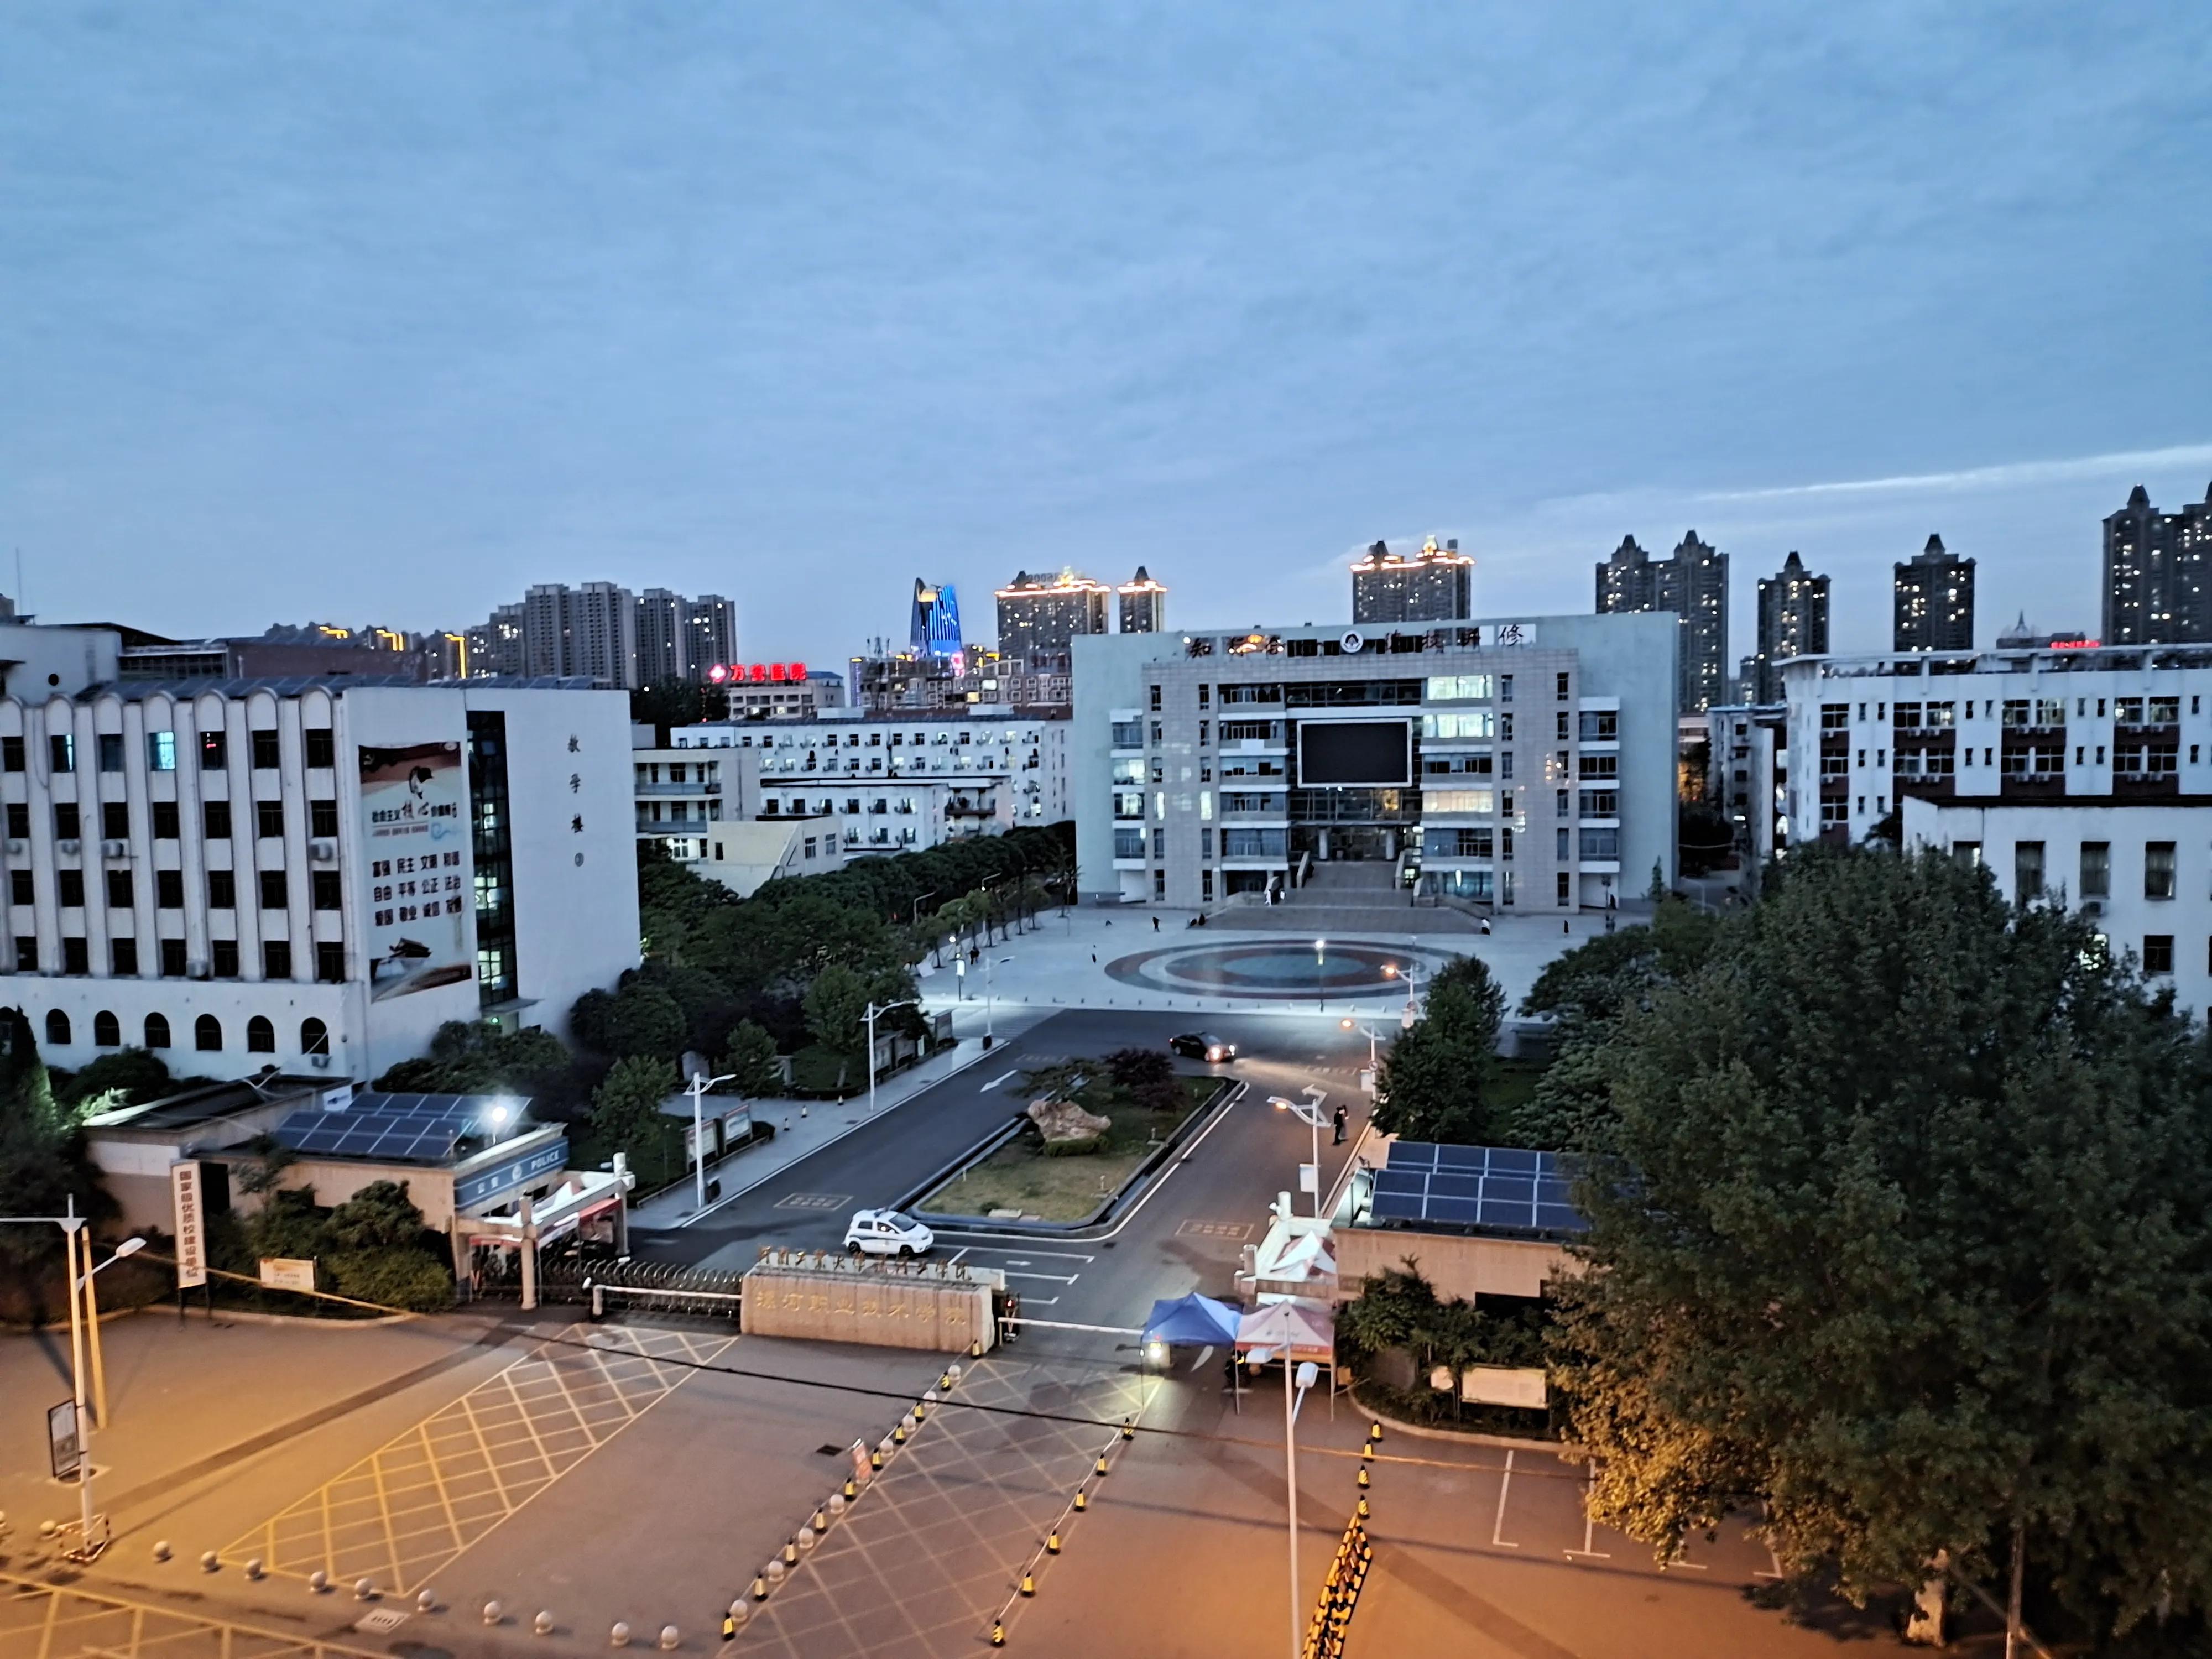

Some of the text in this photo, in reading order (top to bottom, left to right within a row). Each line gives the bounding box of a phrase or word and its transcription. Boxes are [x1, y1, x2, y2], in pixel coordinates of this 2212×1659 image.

[397, 857, 415, 874] 民主
[420, 854, 437, 870] 文明
[373, 885, 392, 902] 自由
[398, 881, 415, 898] 平等
[422, 878, 439, 894] 公正
[530, 1150, 560, 1171] POLICE
[756, 1291, 967, 1326] 漯河职业技术学院
